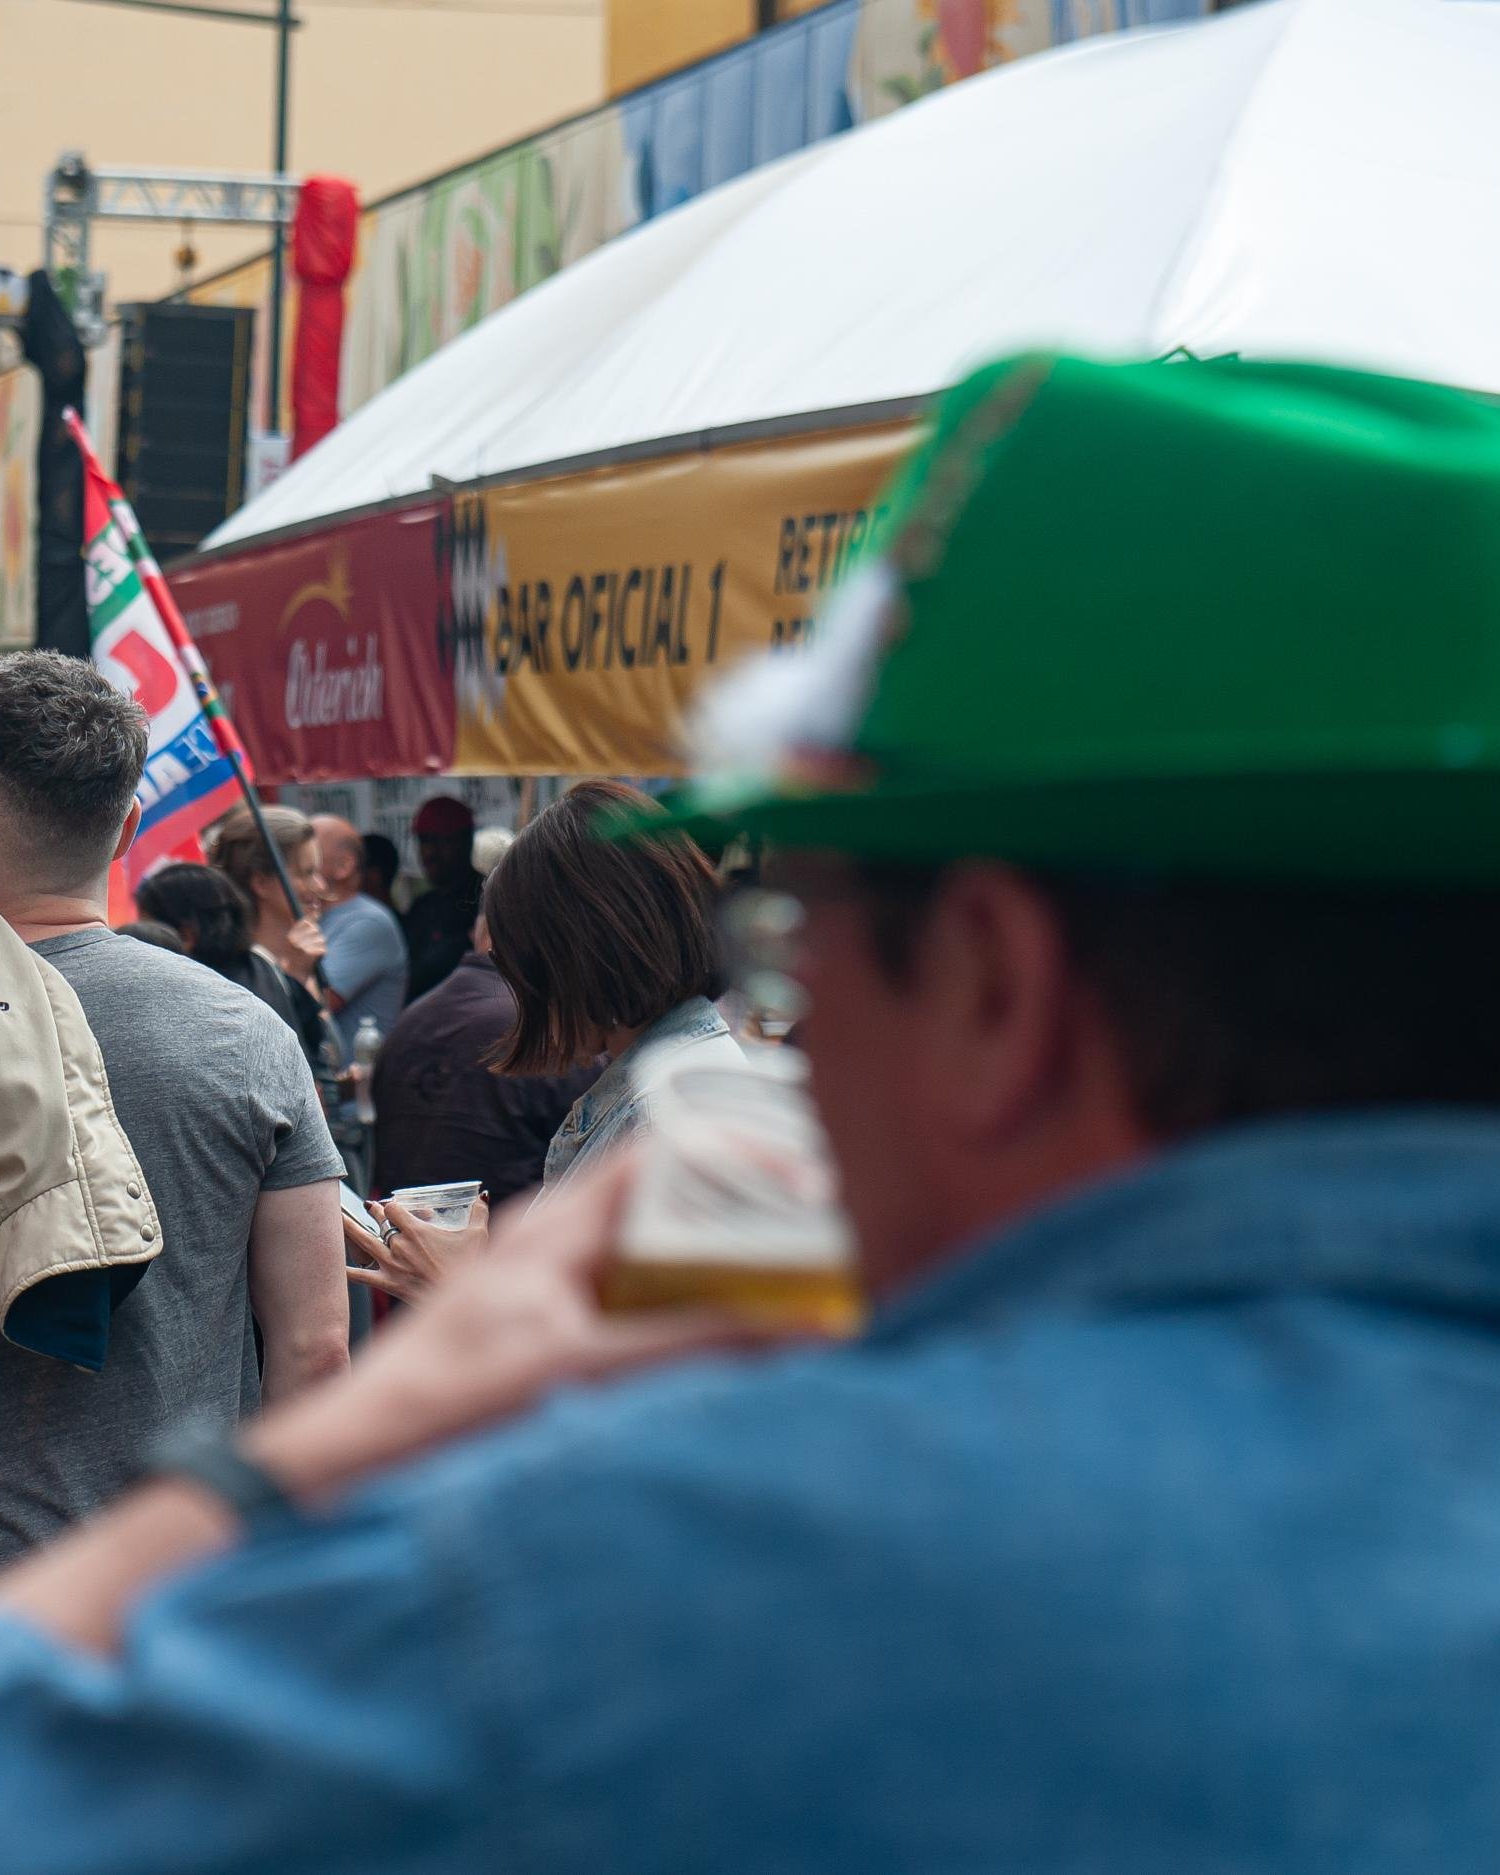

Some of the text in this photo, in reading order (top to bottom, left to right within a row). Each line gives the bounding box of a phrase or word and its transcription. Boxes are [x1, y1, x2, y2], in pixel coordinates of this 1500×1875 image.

[495, 581, 553, 676] BAR
[562, 561, 693, 672] OFICIAL
[707, 558, 727, 662] 1
